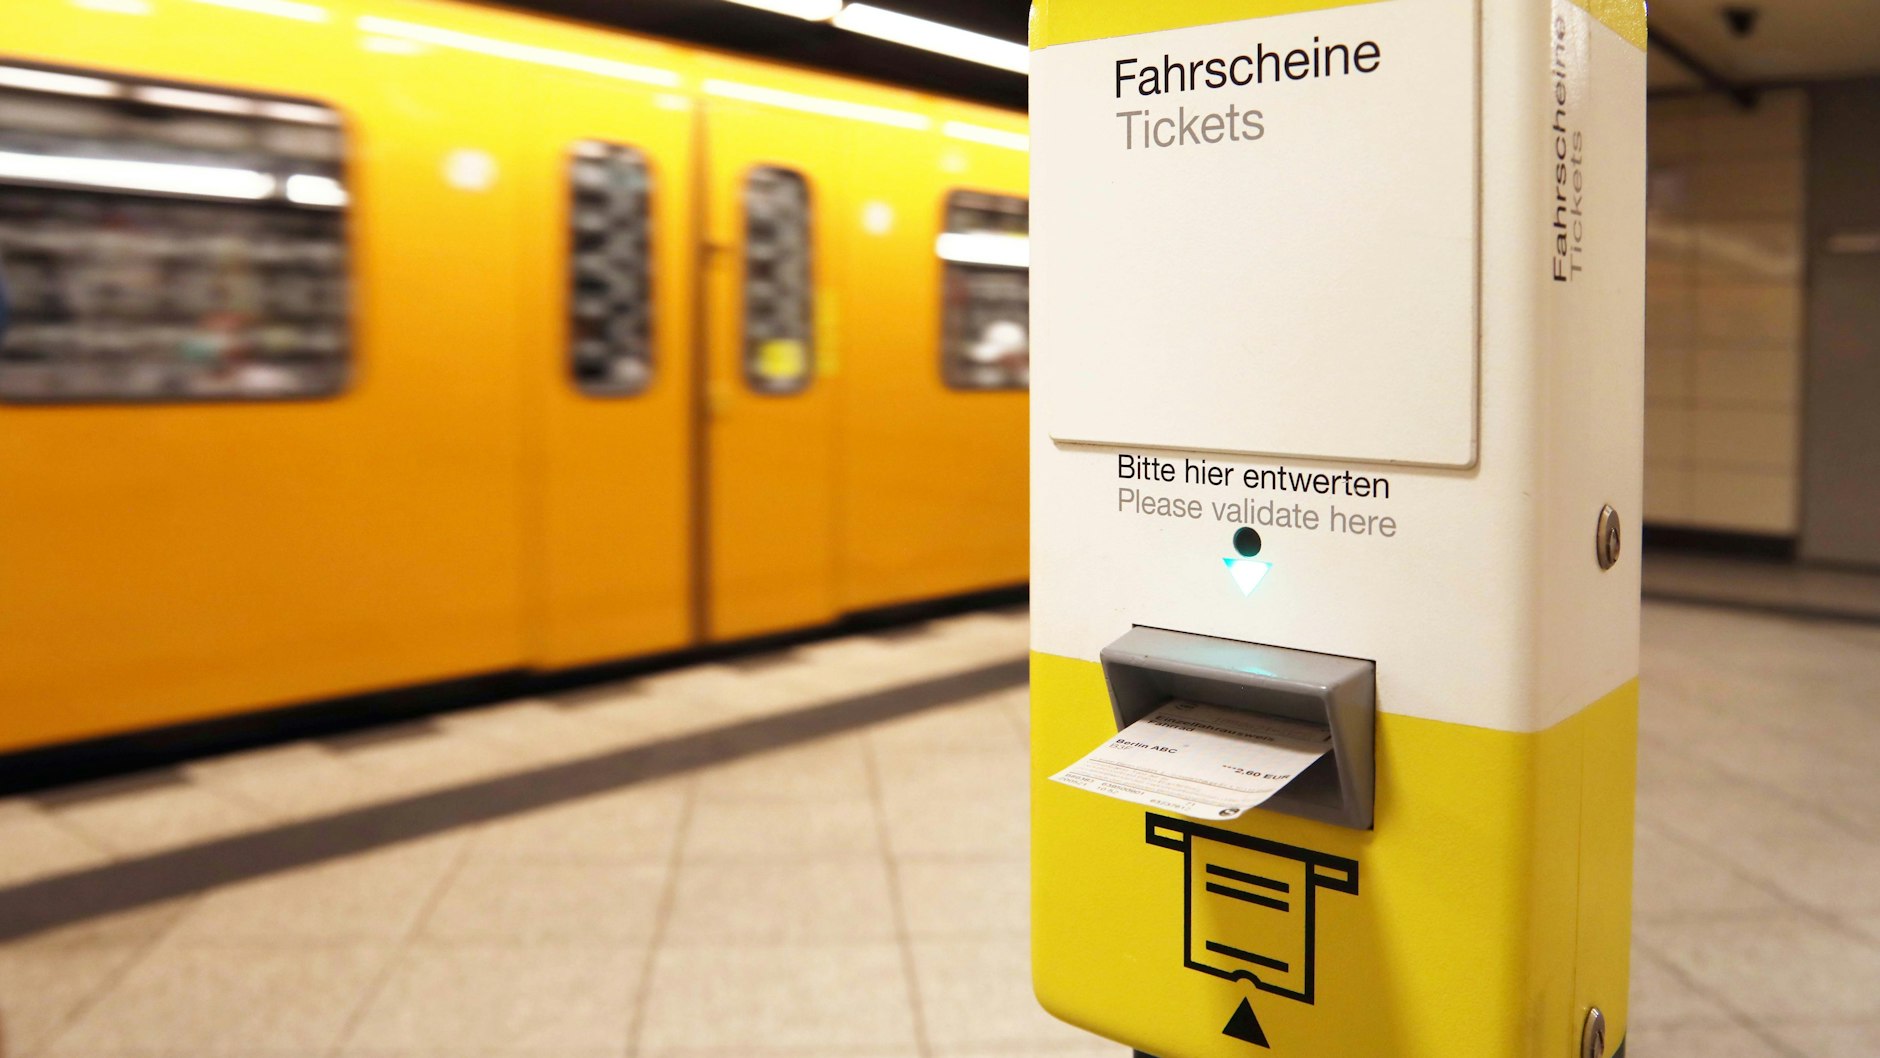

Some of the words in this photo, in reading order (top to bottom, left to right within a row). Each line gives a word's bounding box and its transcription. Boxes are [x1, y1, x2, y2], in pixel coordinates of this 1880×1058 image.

[1115, 36, 1381, 98] Fahrscheine
[1116, 104, 1265, 150] Tickets
[1553, 15, 1567, 282] Fahrscheine
[1570, 130, 1582, 282] Tickets
[1118, 454, 1176, 482] Bitte
[1185, 459, 1234, 486] hier
[1243, 466, 1390, 499] entwerten
[1118, 487, 1203, 519] Please
[1212, 498, 1319, 530] validate
[1330, 505, 1397, 538] here
[1116, 738, 1149, 749] Berlin
[1150, 745, 1178, 754] ABC
[1147, 720, 1195, 732] Fahrrad
